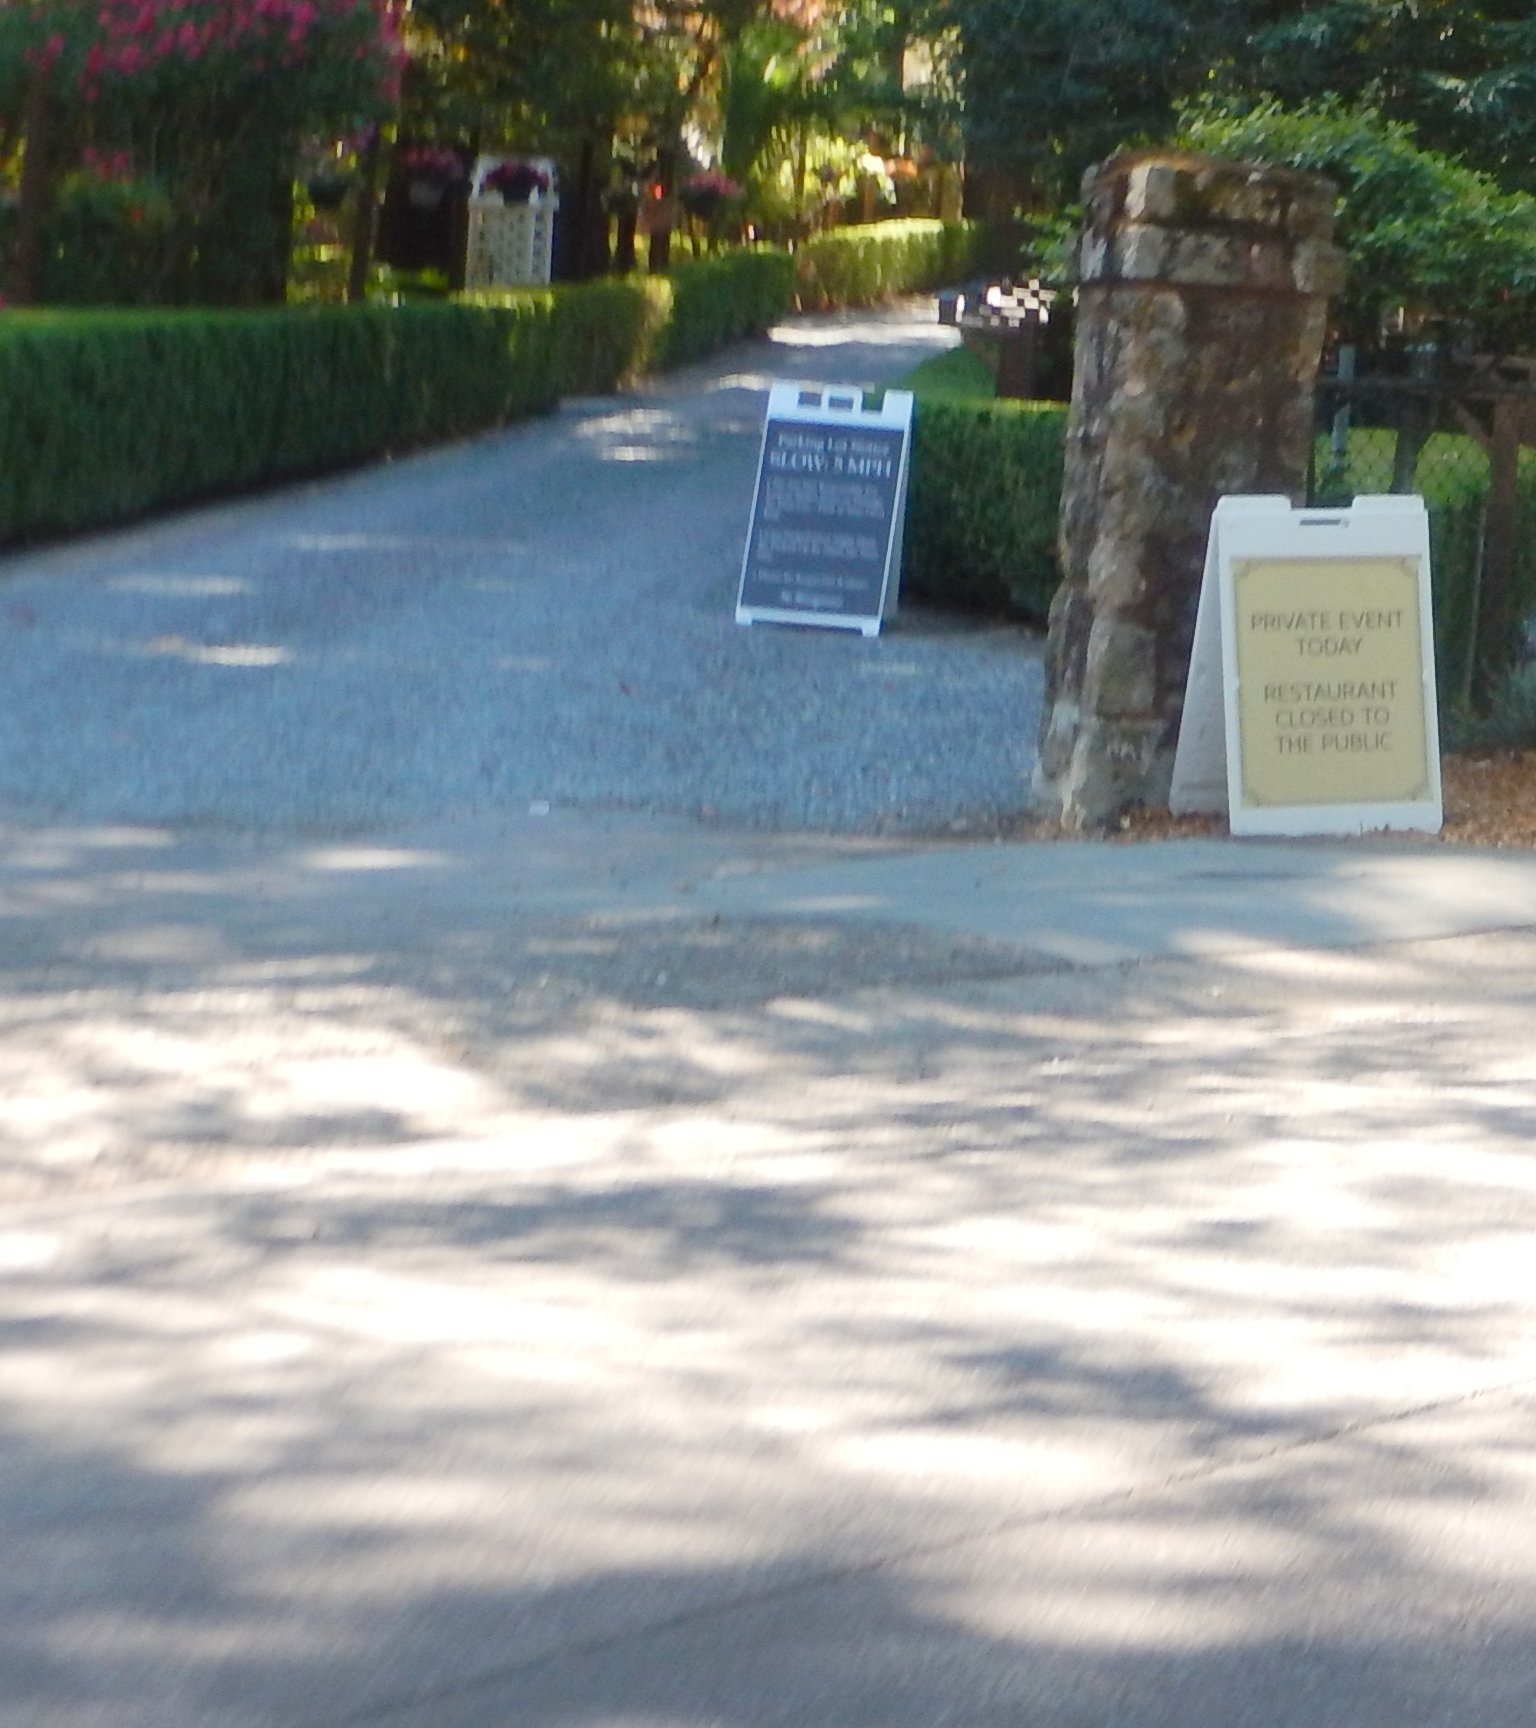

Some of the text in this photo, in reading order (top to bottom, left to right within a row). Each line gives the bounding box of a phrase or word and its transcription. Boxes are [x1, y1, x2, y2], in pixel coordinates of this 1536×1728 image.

[1250, 610, 1405, 632] PRIVATE EVENT
[1297, 636, 1363, 657] TODAY
[1264, 681, 1398, 704] RESTAURANT
[1274, 706, 1391, 729] CLOSED TO
[1275, 731, 1393, 754] THE PUBLIC
